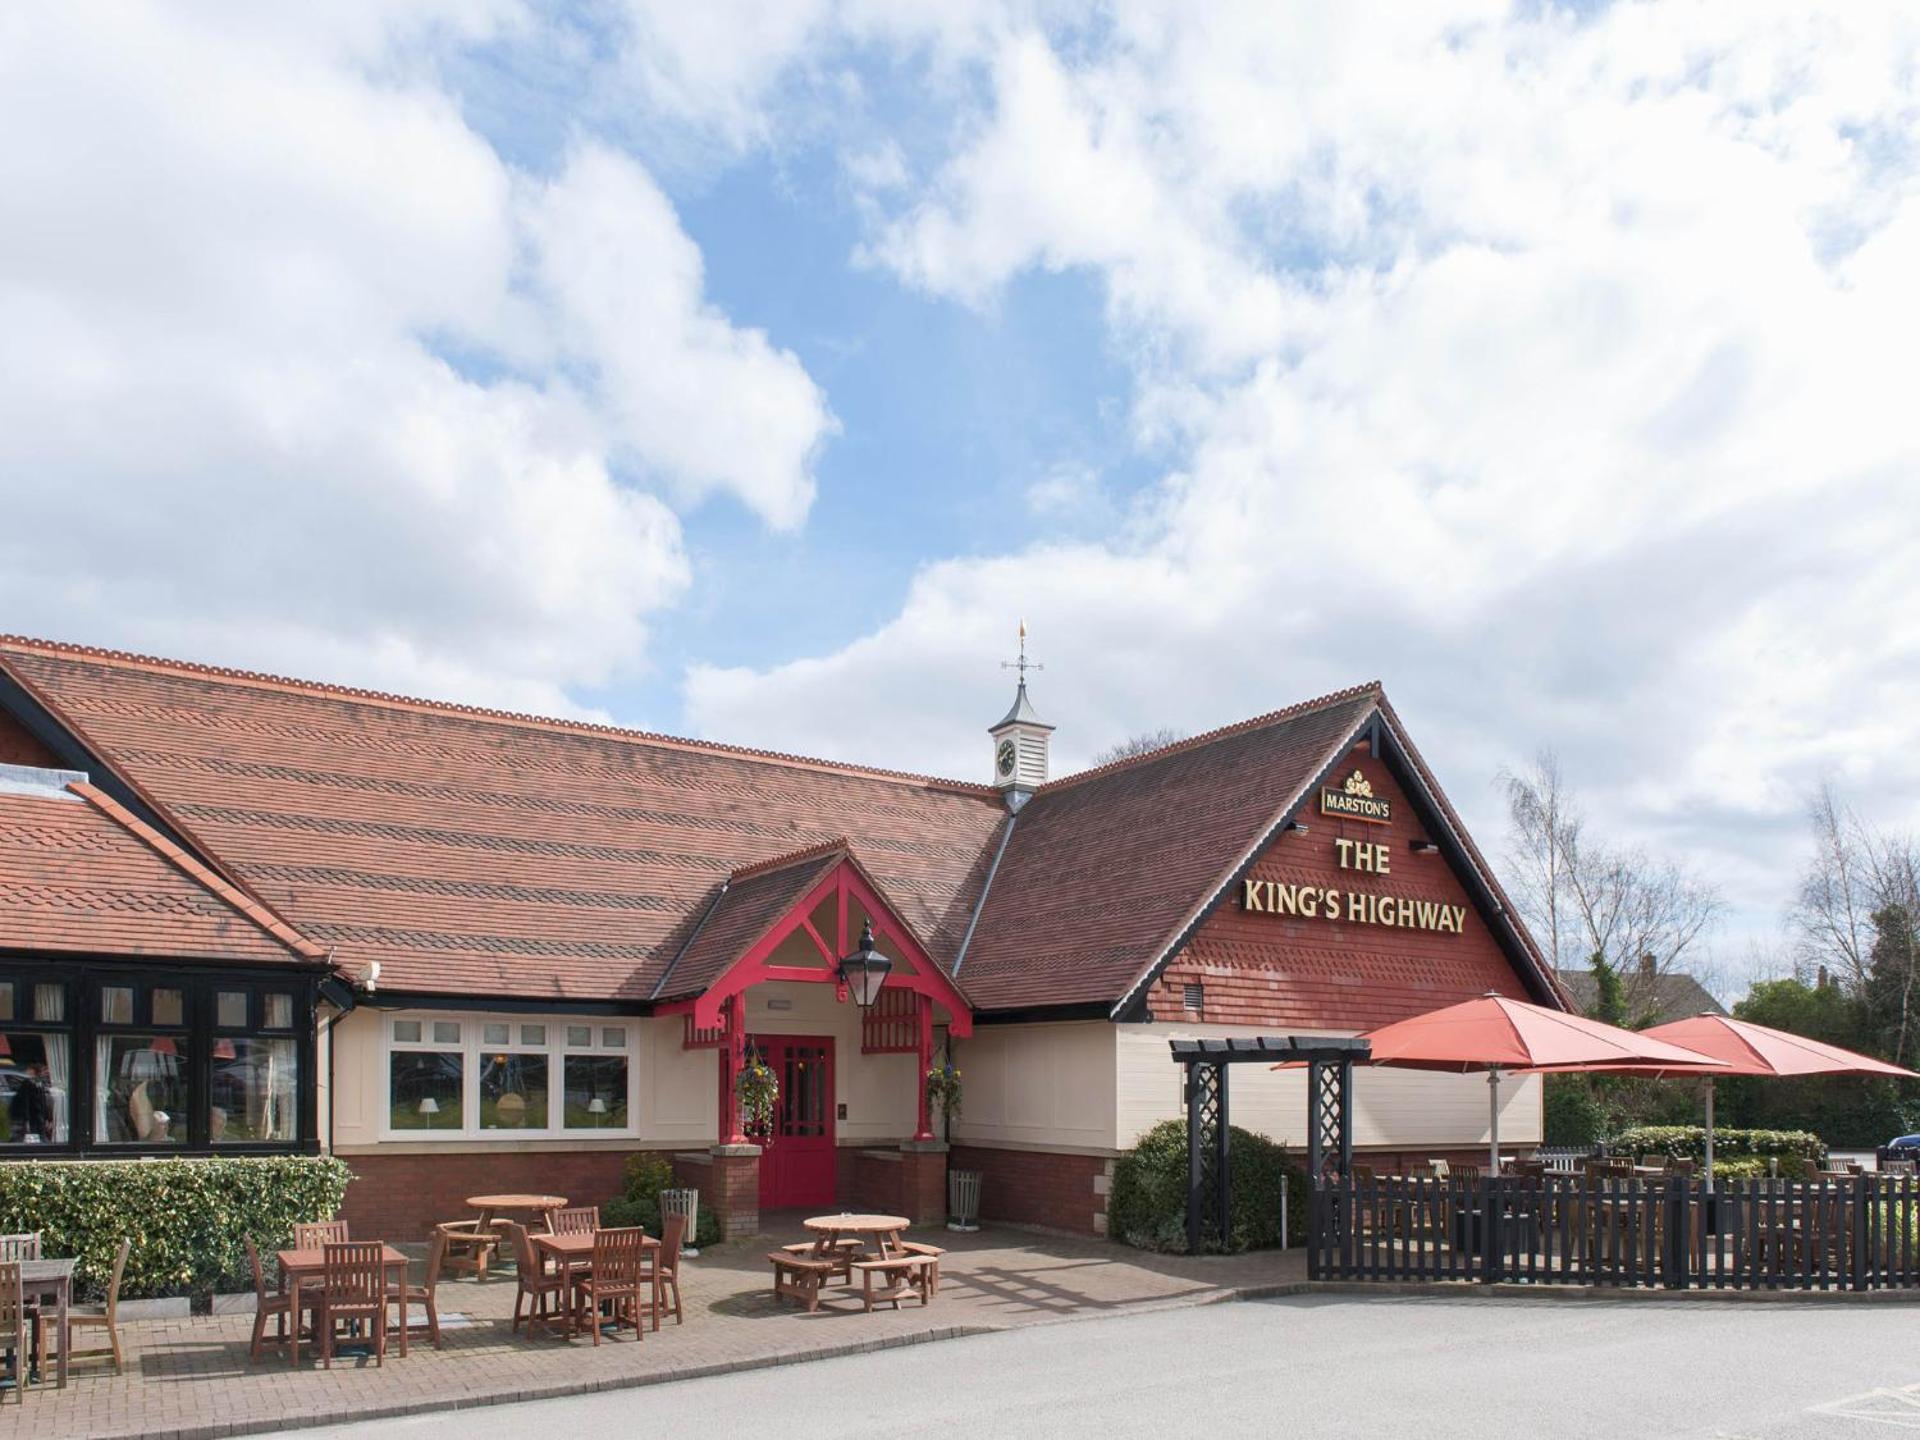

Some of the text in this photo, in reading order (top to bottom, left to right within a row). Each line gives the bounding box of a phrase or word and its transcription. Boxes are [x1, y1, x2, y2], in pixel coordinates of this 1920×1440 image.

[1326, 794, 1389, 817] MARSTON'S
[1335, 838, 1390, 874] THE
[1245, 880, 1466, 933] KING'S HIGHWAY
